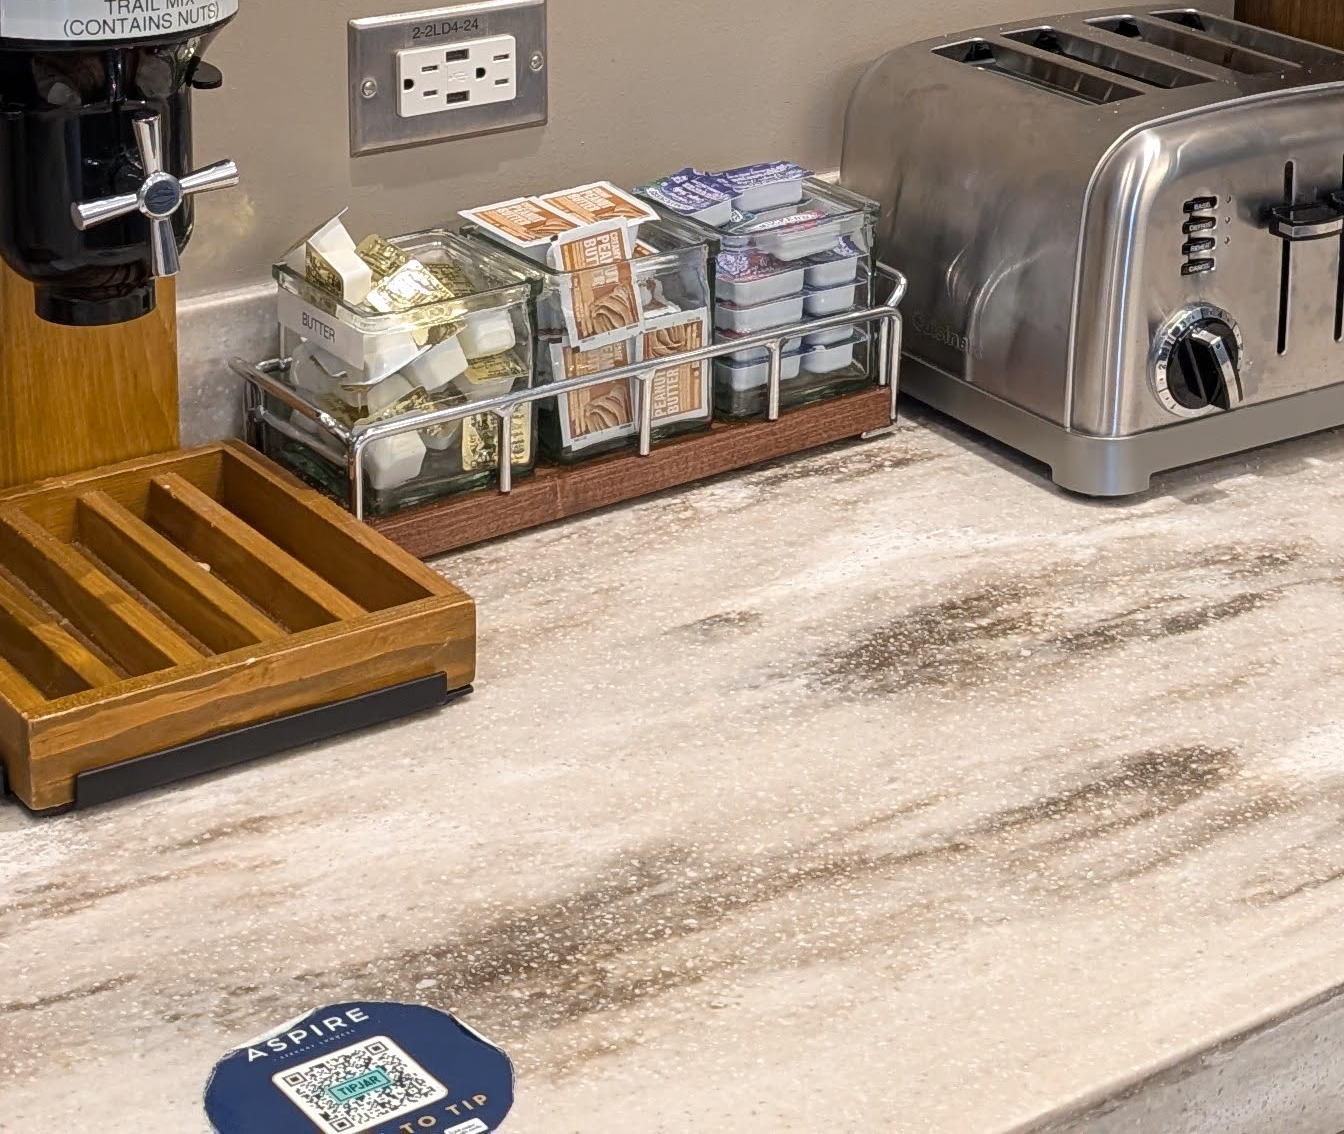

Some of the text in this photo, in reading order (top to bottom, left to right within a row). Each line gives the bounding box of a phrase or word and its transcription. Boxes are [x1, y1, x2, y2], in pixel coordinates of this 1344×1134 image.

[63, 1, 221, 38] (CONTAINS NUTS)
[412, 18, 480, 40] 2-2LD4-24
[301, 311, 336, 343] BUTTER
[912, 309, 984, 362] Cuisina
[653, 370, 667, 417] PEANUT
[666, 367, 679, 415] BUTTER
[246, 1007, 370, 1062] ASPIRE
[337, 1075, 382, 1096] TIPJAR
[399, 1115, 437, 1134] TO
[444, 1094, 487, 1116] TIP
